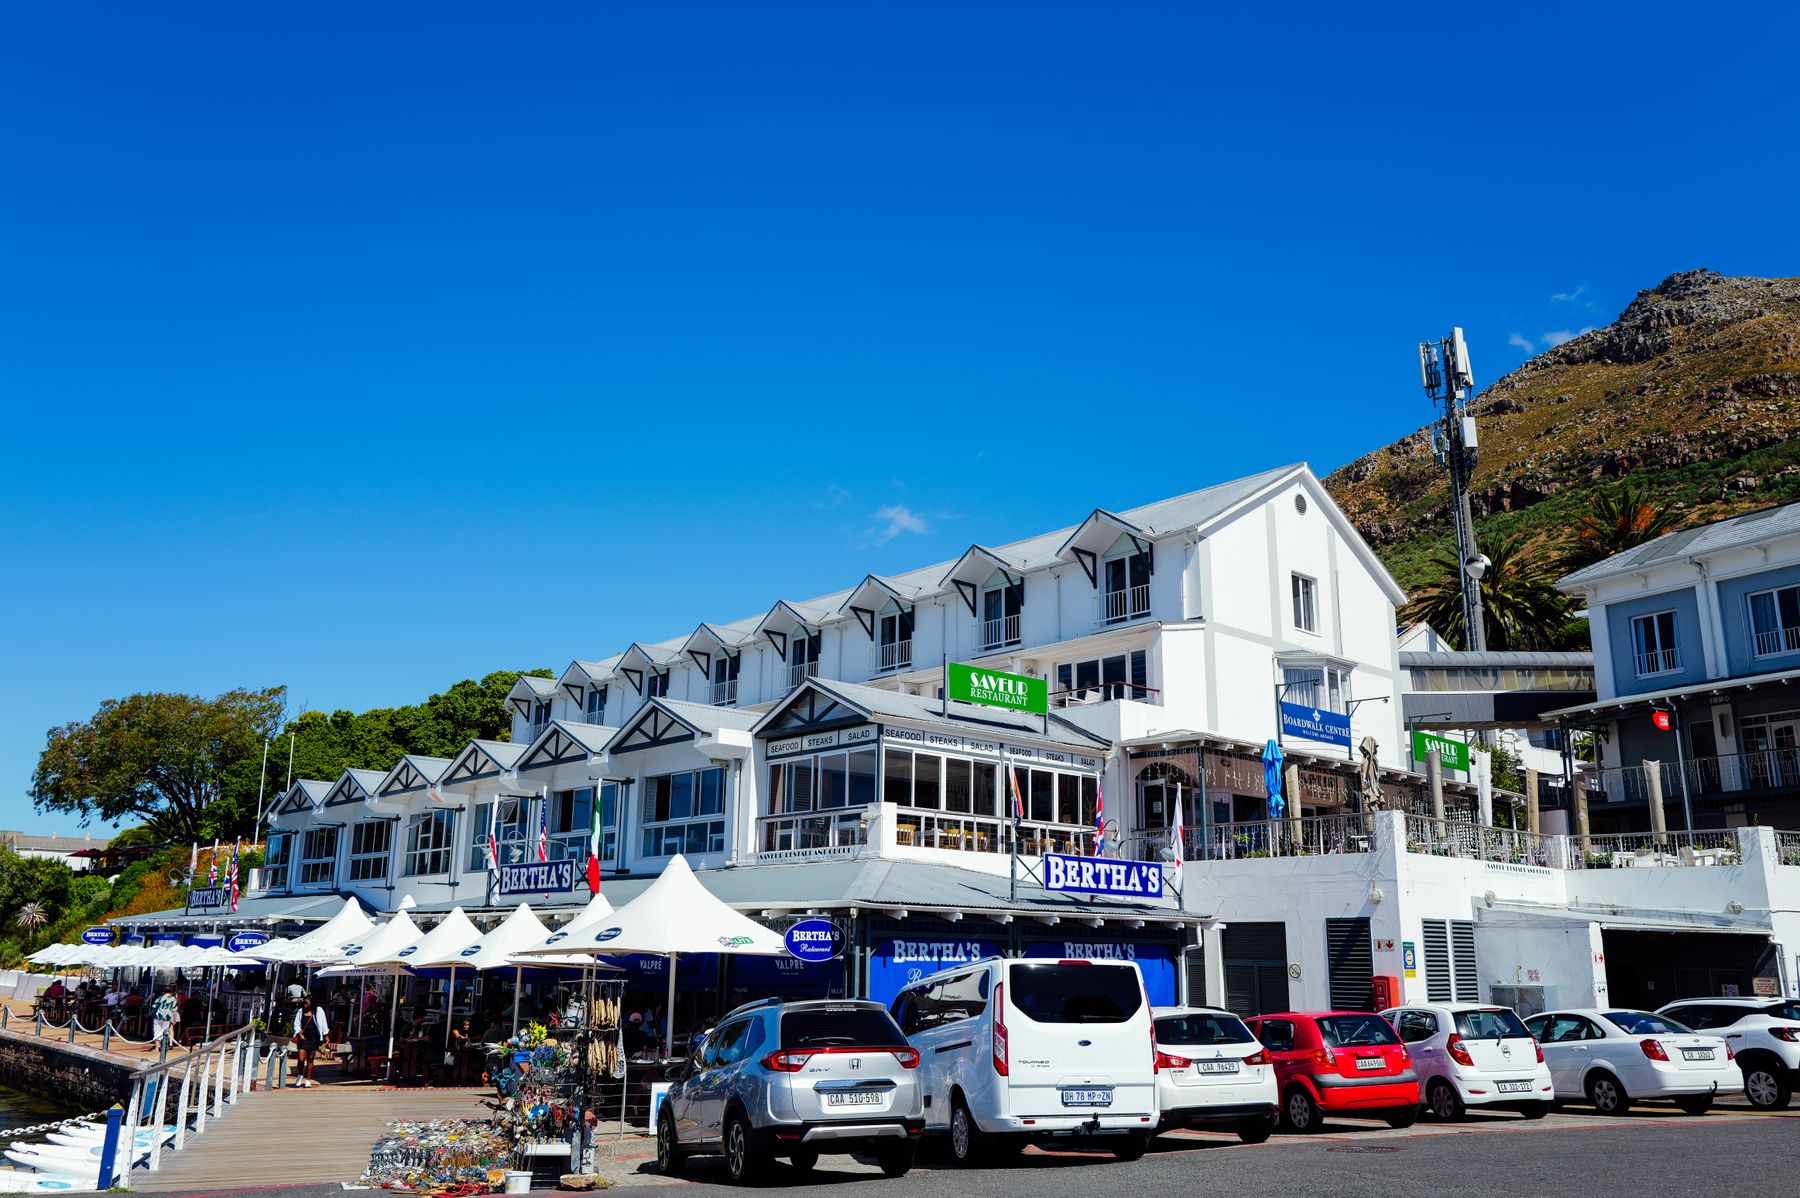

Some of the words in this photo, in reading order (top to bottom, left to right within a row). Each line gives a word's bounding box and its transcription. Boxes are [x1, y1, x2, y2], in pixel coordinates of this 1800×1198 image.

[970, 672, 1028, 697] SAVEUR
[970, 687, 1028, 706] RESTAURANT
[1283, 713, 1324, 732] BOARDWALK
[1325, 724, 1351, 738] CENTRE
[847, 729, 870, 740] SALAD
[885, 728, 922, 741] SEAFOOD
[770, 741, 799, 753] SEAFOOD
[807, 735, 833, 747] STEAKS
[929, 735, 958, 747] STEAKS
[970, 742, 994, 752] SALAD
[1425, 737, 1458, 757] SAVEUR
[1009, 747, 1032, 758] SEAFOOD
[1046, 752, 1065, 762] STEAKS
[1080, 757, 1095, 767] SALAD
[501, 863, 571, 893] BERTHA'S
[1048, 856, 1160, 894] BERTHA'S
[191, 889, 221, 907] BERTHA'S
[792, 930, 840, 942] BERTHA'S
[799, 943, 832, 953] Restaurant
[893, 939, 981, 963] BERTHA'S
[1063, 941, 1136, 961] BERTHA'S
[1202, 1063, 1215, 1072] CAA
[830, 1094, 845, 1105] CAA
[849, 1091, 880, 1104] 510-598
[1064, 1092, 1074, 1101] BH
[1076, 1092, 1085, 1101] 78
[1087, 1092, 1096, 1101] MP
[1101, 1092, 1111, 1101] ZN
